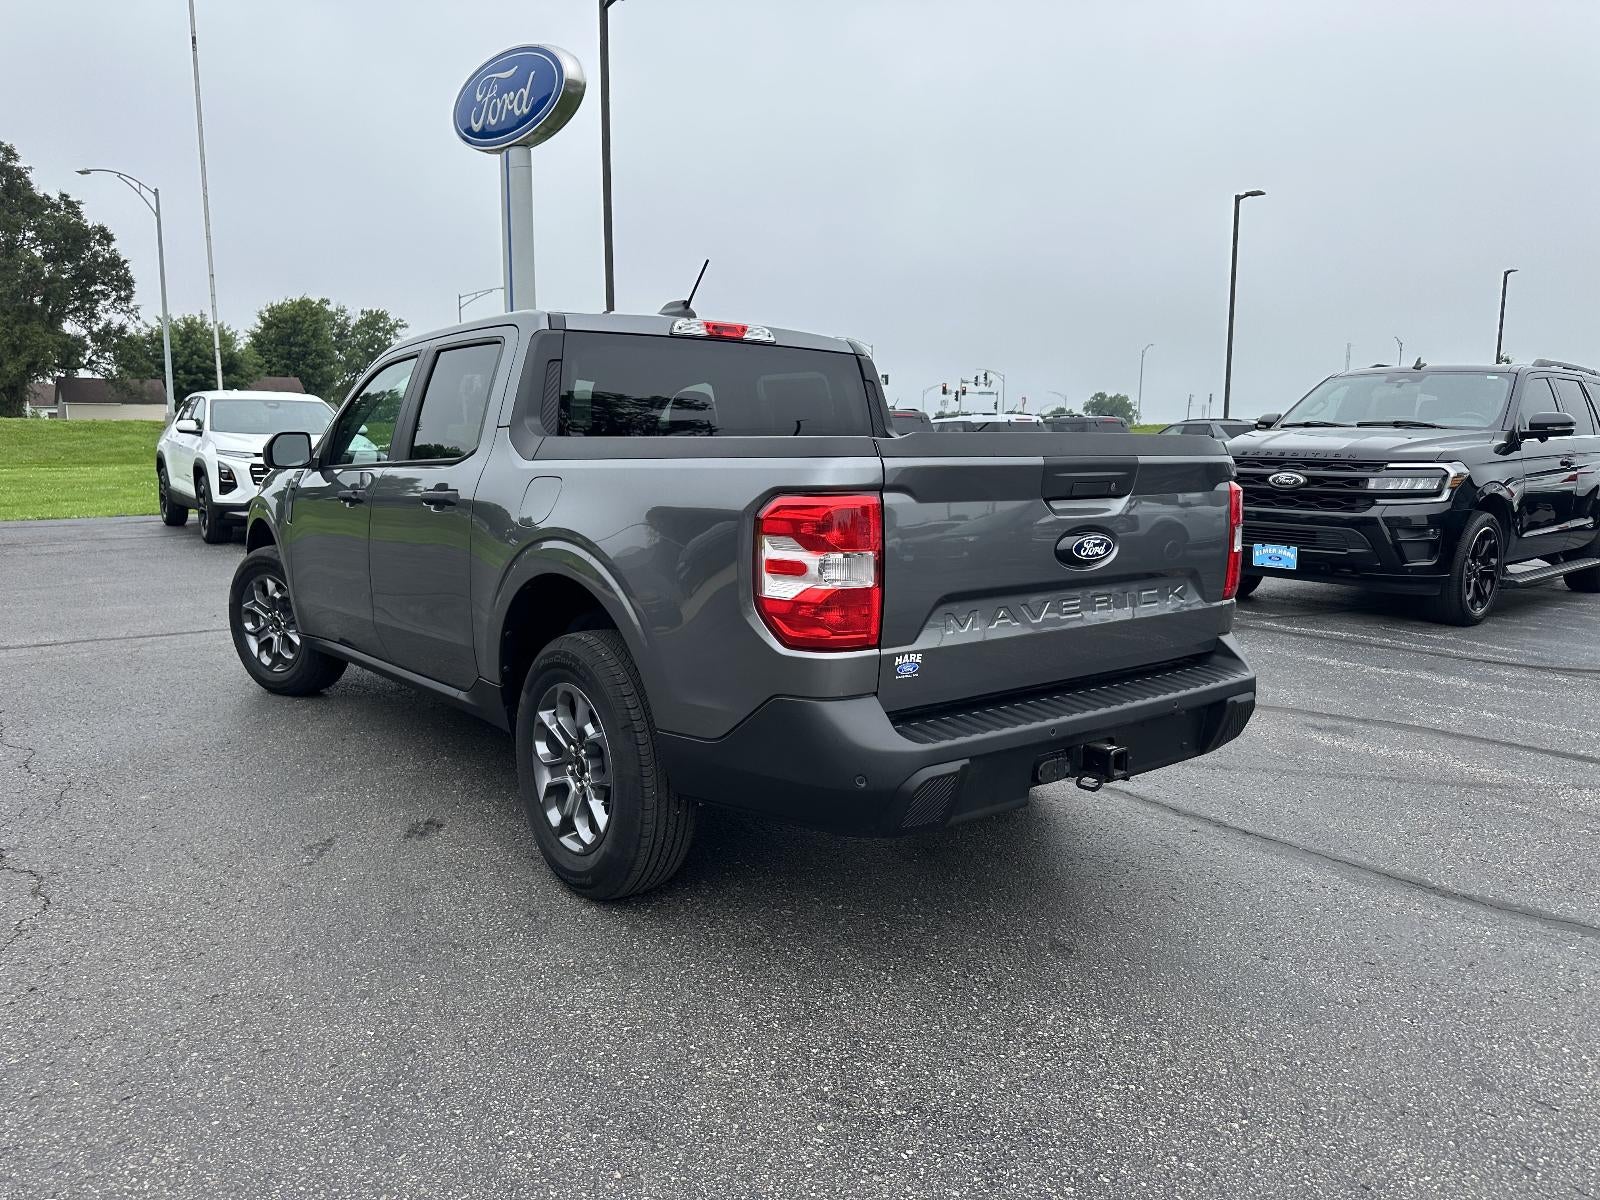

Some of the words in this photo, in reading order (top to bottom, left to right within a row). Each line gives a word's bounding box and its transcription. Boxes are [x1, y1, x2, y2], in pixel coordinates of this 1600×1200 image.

[470, 65, 536, 132] Ford
[1240, 450, 1358, 459] EXPEDITION
[1275, 475, 1296, 486] Ford
[1080, 539, 1107, 556] Ford
[1255, 548, 1277, 556] ELMER
[944, 584, 1185, 635] MAVERICK
[894, 653, 923, 666] HARE
